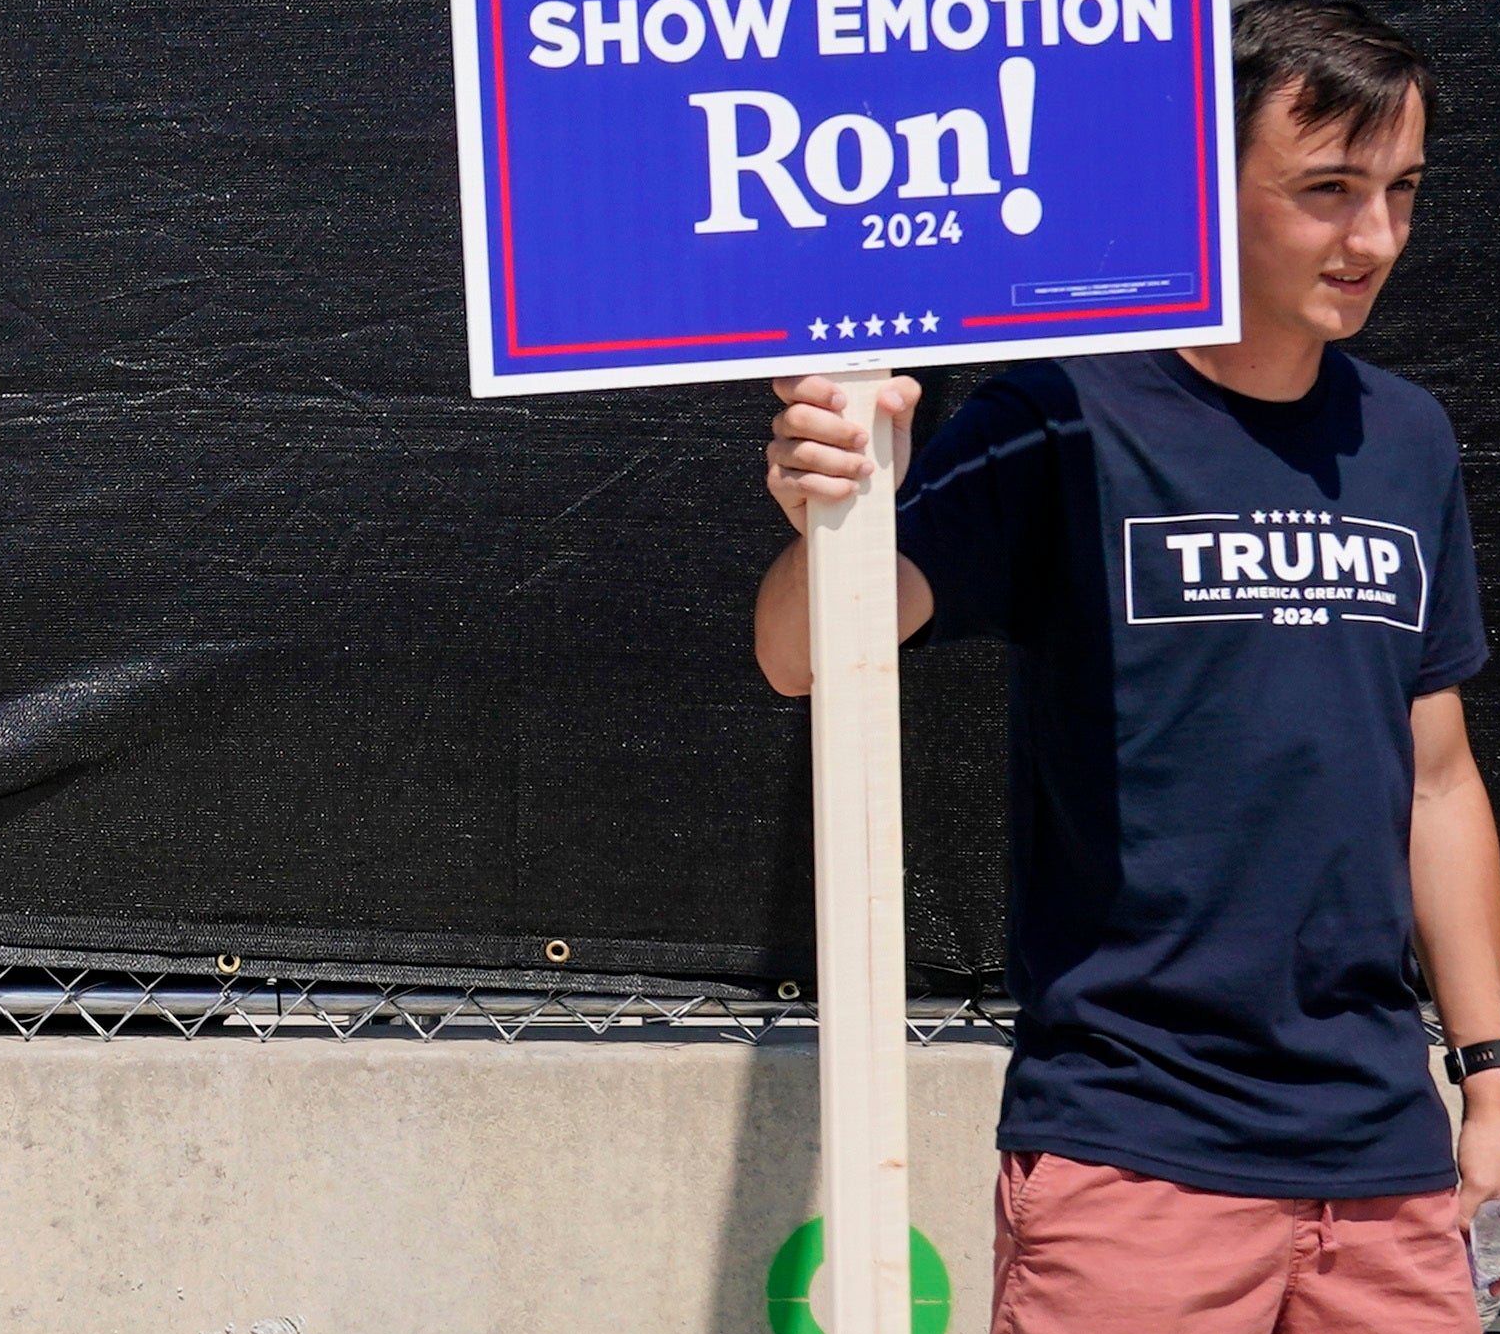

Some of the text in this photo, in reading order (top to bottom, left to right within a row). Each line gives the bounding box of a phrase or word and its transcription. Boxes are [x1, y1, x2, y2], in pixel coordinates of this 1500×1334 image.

[688, 56, 1043, 235] Ron!
[861, 210, 963, 250] 2024
[1166, 531, 1401, 585] TRUMP
[1183, 587, 1232, 602] MAKE
[1235, 587, 1301, 601] AMERICA
[1303, 586, 1354, 602] GREAT
[1272, 607, 1330, 625] 2024
